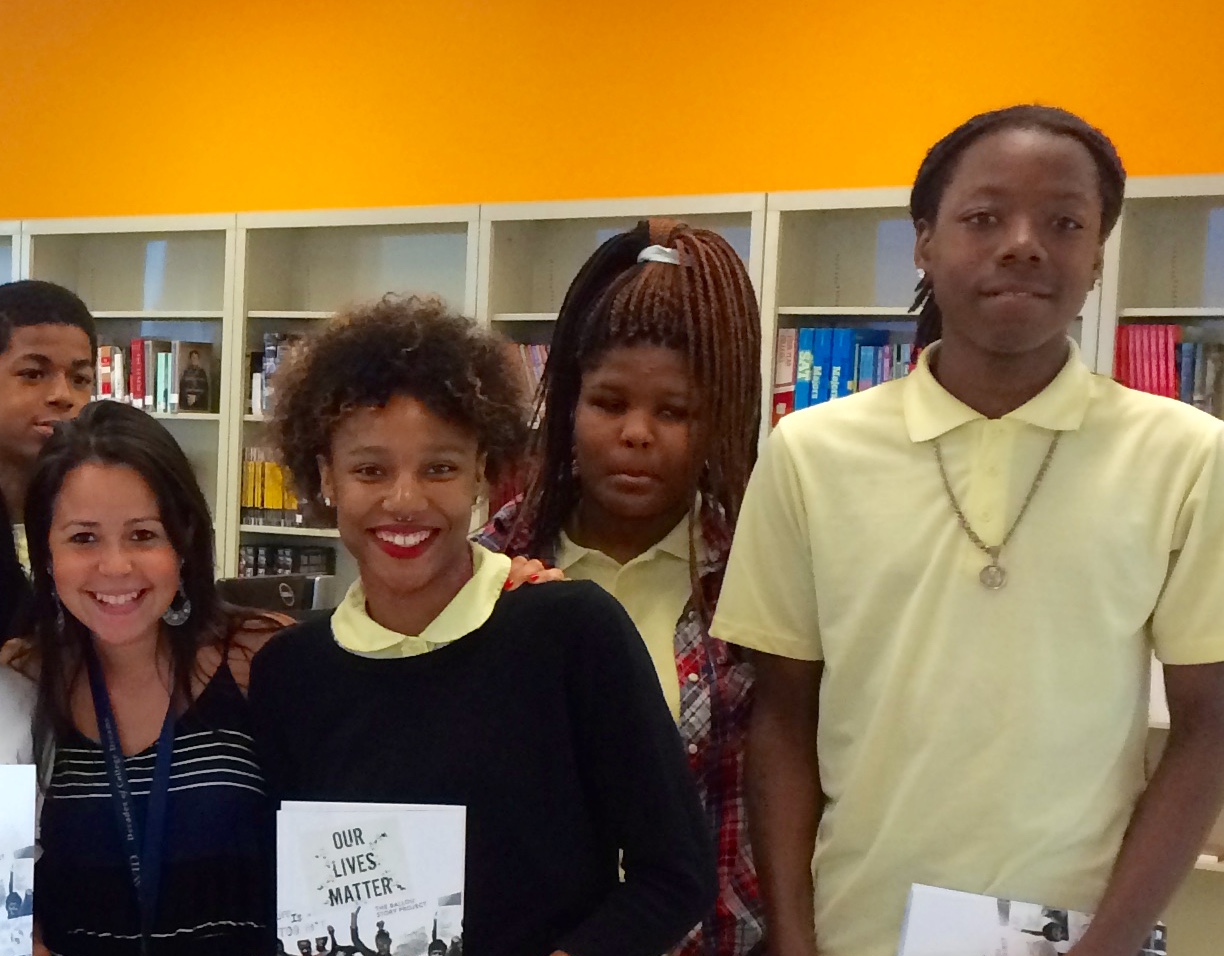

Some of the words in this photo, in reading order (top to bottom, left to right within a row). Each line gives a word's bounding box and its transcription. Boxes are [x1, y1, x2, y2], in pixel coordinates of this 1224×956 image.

[798, 350, 814, 381] SAT
[332, 827, 365, 849] OUR
[332, 852, 376, 878] LIVES
[328, 876, 394, 907] MATTER
